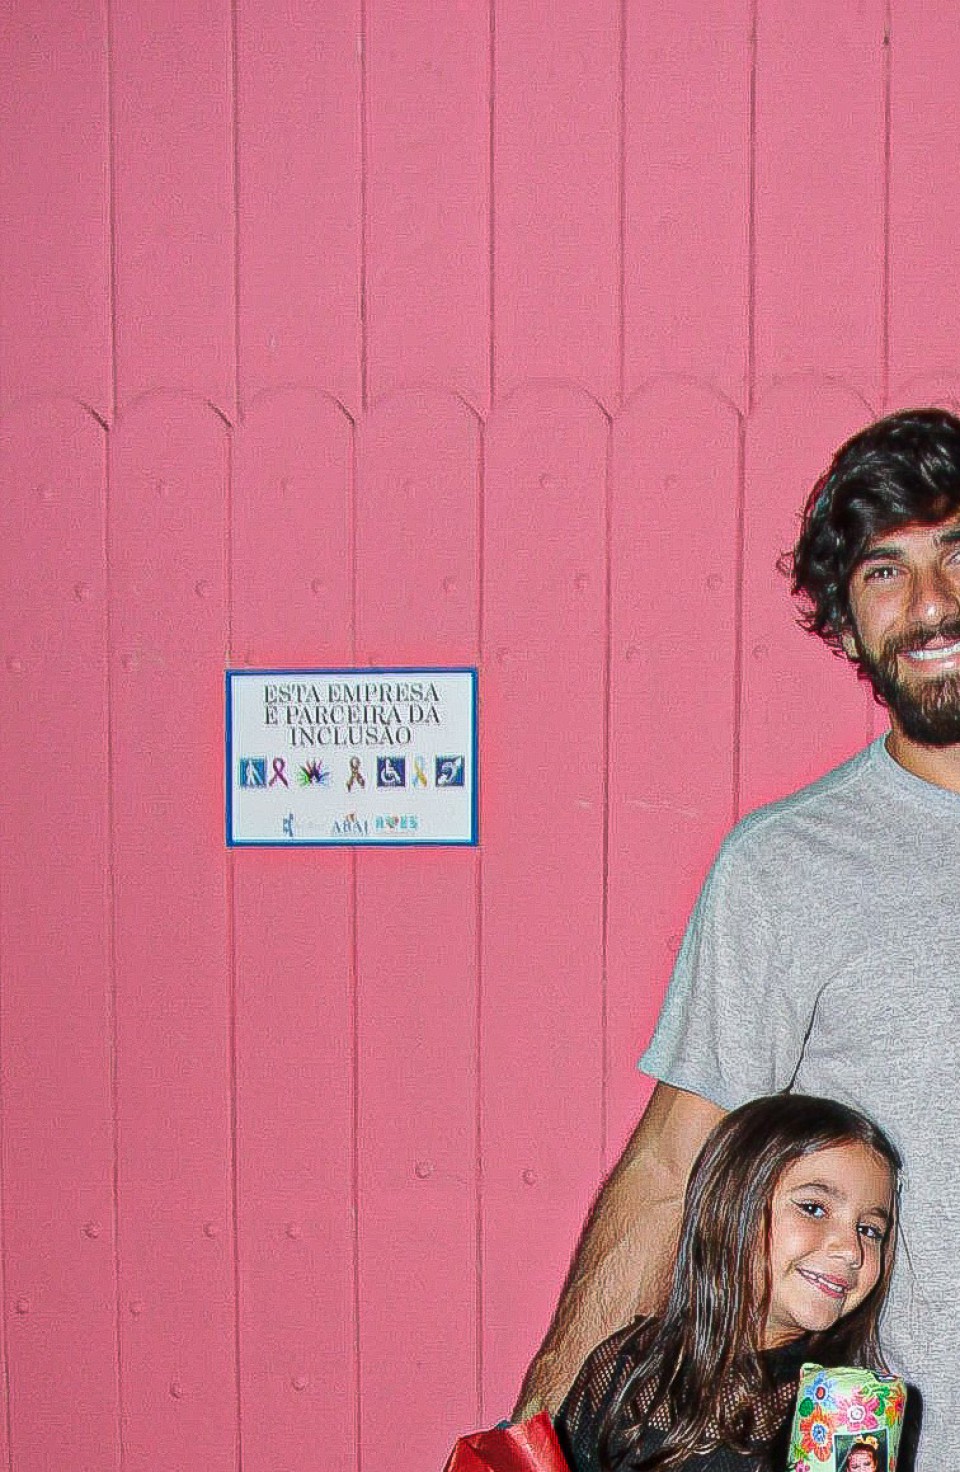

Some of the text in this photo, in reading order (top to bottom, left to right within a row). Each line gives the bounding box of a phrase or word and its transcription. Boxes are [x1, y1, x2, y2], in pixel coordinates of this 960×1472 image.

[264, 682, 440, 703] ESTA EMPRESA
[286, 704, 401, 725] PARCEIRA
[409, 703, 440, 724] DA
[291, 725, 411, 746] INCLUSÃO
